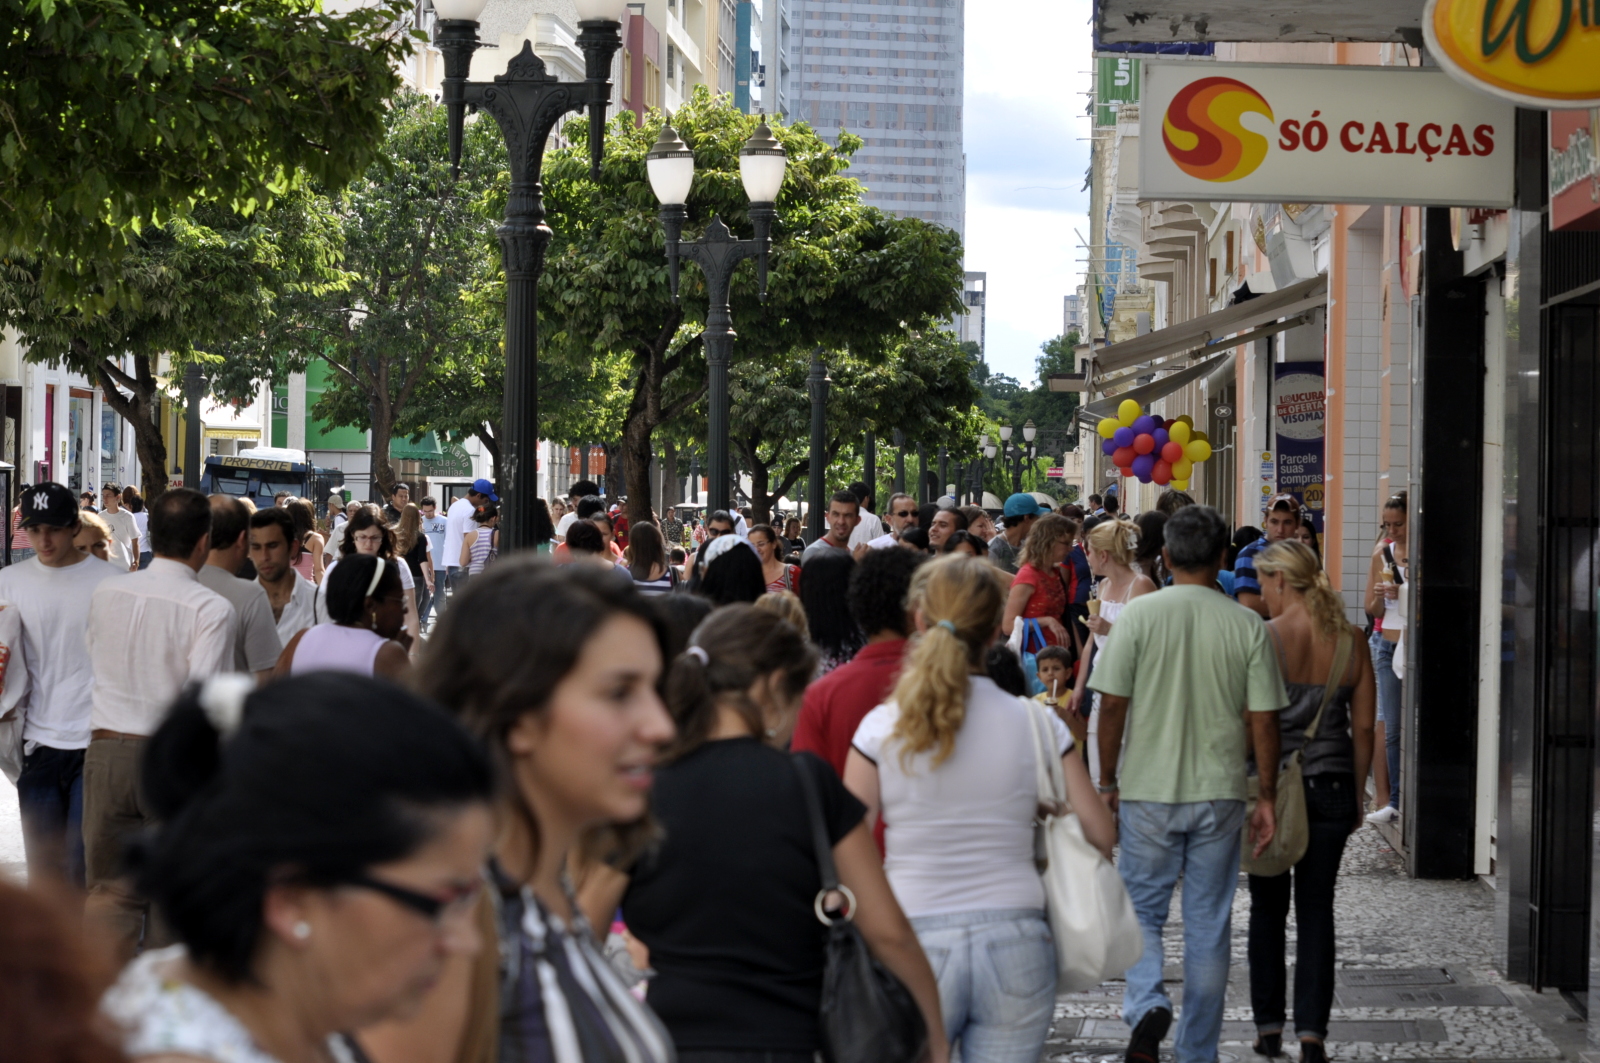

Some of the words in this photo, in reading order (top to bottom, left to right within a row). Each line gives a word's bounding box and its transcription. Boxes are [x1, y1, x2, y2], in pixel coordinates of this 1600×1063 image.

[1278, 110, 1329, 152] SÓ
[1340, 120, 1495, 163] CALÇAS
[1280, 391, 1325, 405] LOUCURA
[1278, 407, 1288, 415] DE
[223, 456, 289, 471] PROFORTE
[437, 459, 457, 467] das
[1280, 453, 1317, 465] Parcele
[1280, 464, 1304, 474] suas
[1280, 474, 1323, 486] compras
[33, 491, 49, 511] NY
